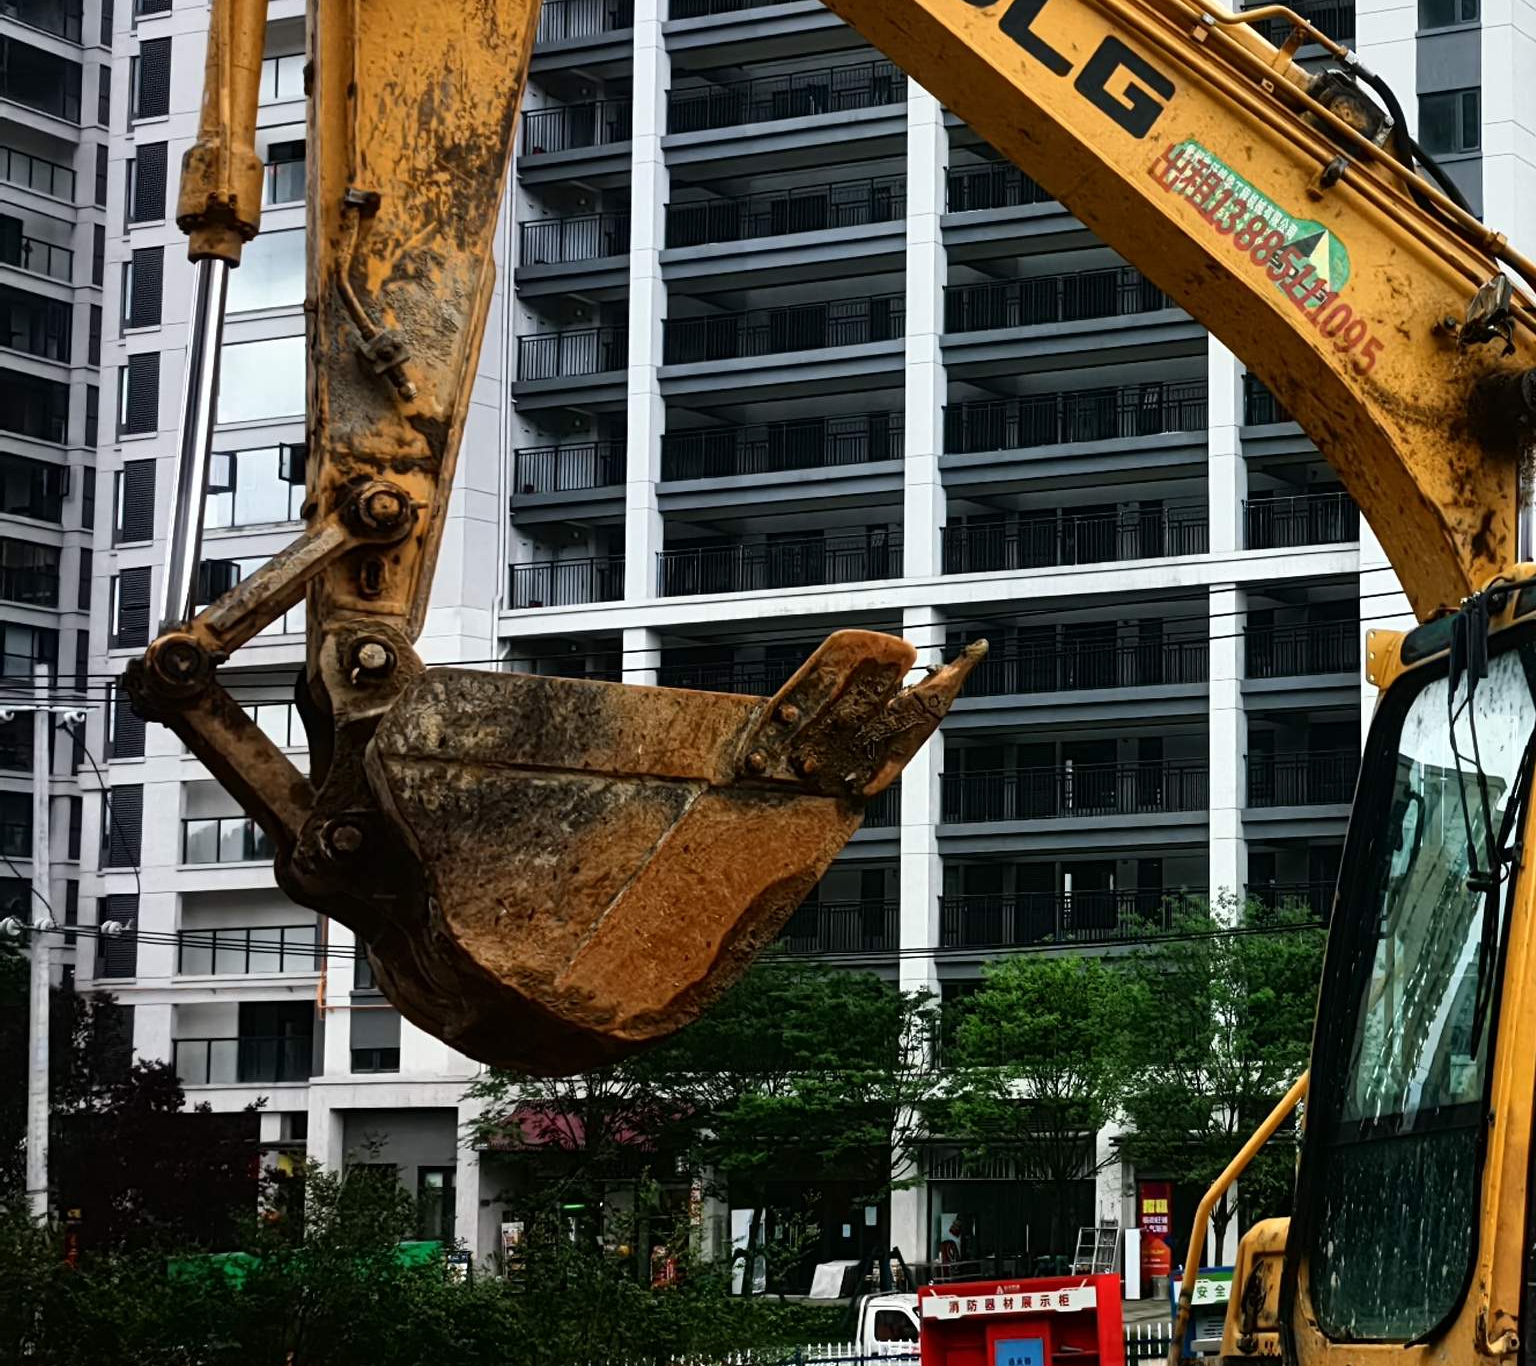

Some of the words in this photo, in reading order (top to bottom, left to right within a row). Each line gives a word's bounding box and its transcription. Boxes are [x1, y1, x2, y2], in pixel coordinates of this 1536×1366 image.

[1196, 1285, 1226, 1300] 安全
[948, 1293, 1071, 1314] 消防器材展示柜
